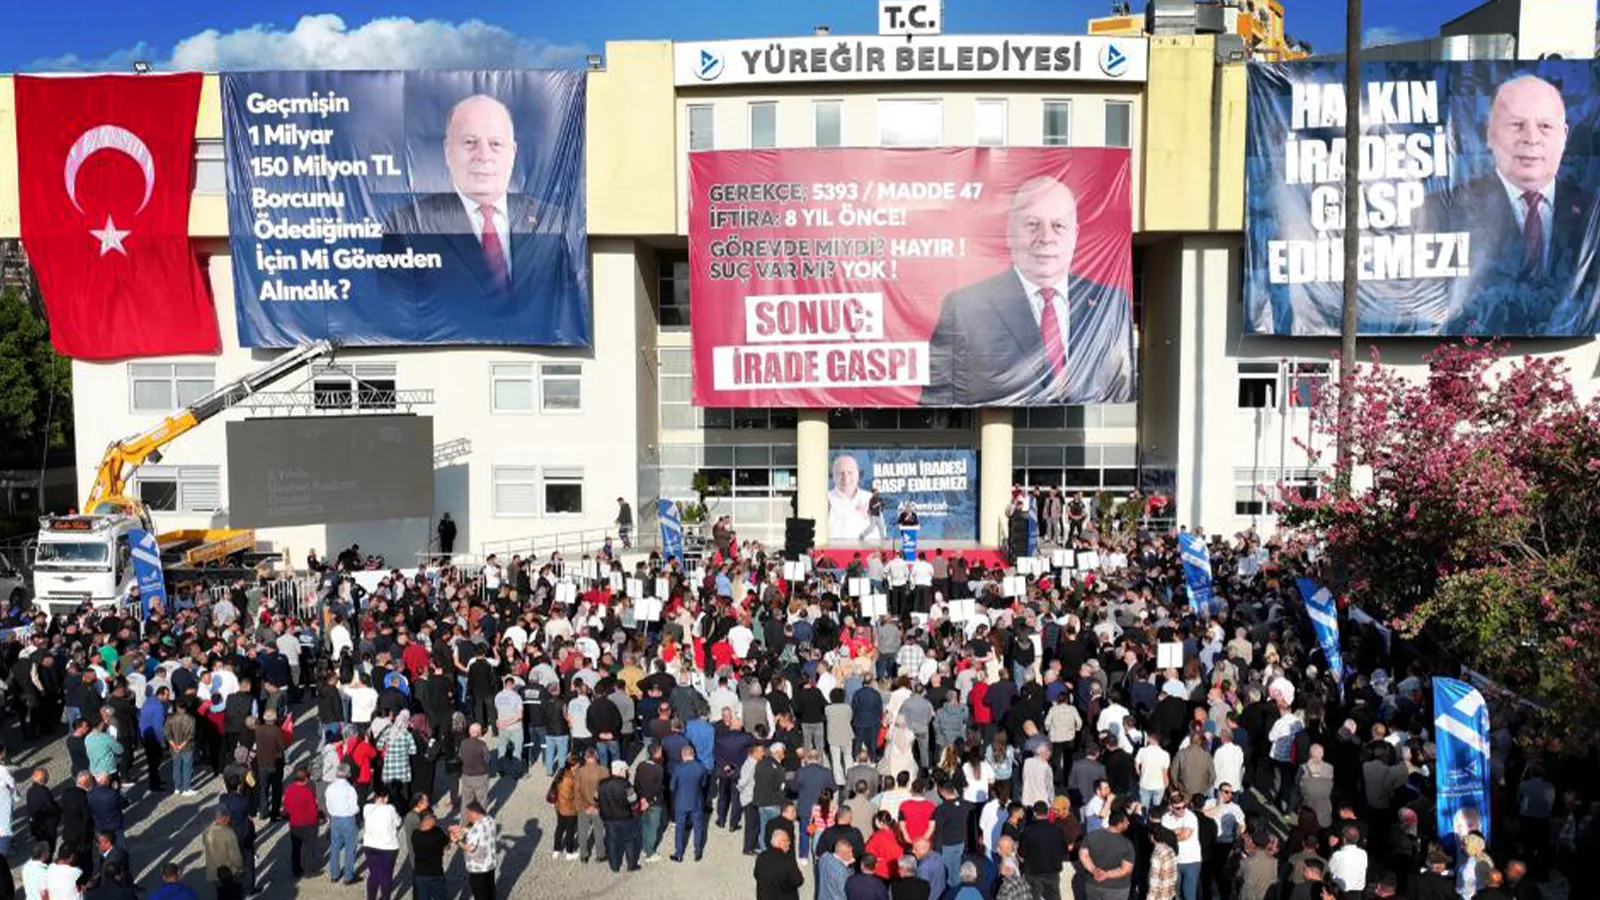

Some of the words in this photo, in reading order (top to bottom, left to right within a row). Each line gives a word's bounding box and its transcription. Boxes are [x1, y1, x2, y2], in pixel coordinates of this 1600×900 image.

[884, 5, 936, 29] T.C.
[741, 41, 885, 74] YÜREĞİR
[896, 40, 1082, 72] BELEDİYESİ
[247, 91, 349, 117] Geçmişin
[1291, 81, 1439, 129] HAKIN
[249, 125, 259, 146] 1
[264, 124, 334, 149] Milyar
[252, 158, 289, 177] 150
[293, 155, 368, 181] Milyon
[371, 155, 401, 176] TL
[252, 188, 345, 208] Borcunu
[812, 183, 858, 201] 5393
[861, 182, 874, 202] /
[877, 182, 955, 200] MADDE
[959, 182, 983, 199] 47
[254, 210, 383, 243] Ödediğimiz
[709, 207, 782, 228] İFTİRA:
[784, 210, 797, 227] 8
[800, 210, 834, 227] YIL
[838, 205, 907, 227] ÖNCE!
[710, 236, 811, 257] GÖREVDE
[815, 234, 885, 256] MİYDİ?
[890, 239, 954, 255] HAYIR
[959, 239, 966, 255] !
[256, 244, 298, 274] İçin
[301, 249, 330, 270] Mi
[333, 247, 442, 270] Görevden
[709, 263, 752, 283] SUÇ
[755, 263, 797, 279] VAR
[841, 262, 887, 279] YOK
[891, 261, 898, 279] !
[259, 278, 351, 301] Alındık?
[755, 299, 874, 342] SONUÇ:
[732, 347, 819, 386] İRADE
[826, 347, 917, 383] GASPI
[873, 463, 916, 476] HALKIN
[921, 460, 966, 475] İRADESİ
[873, 478, 905, 492] GASP
